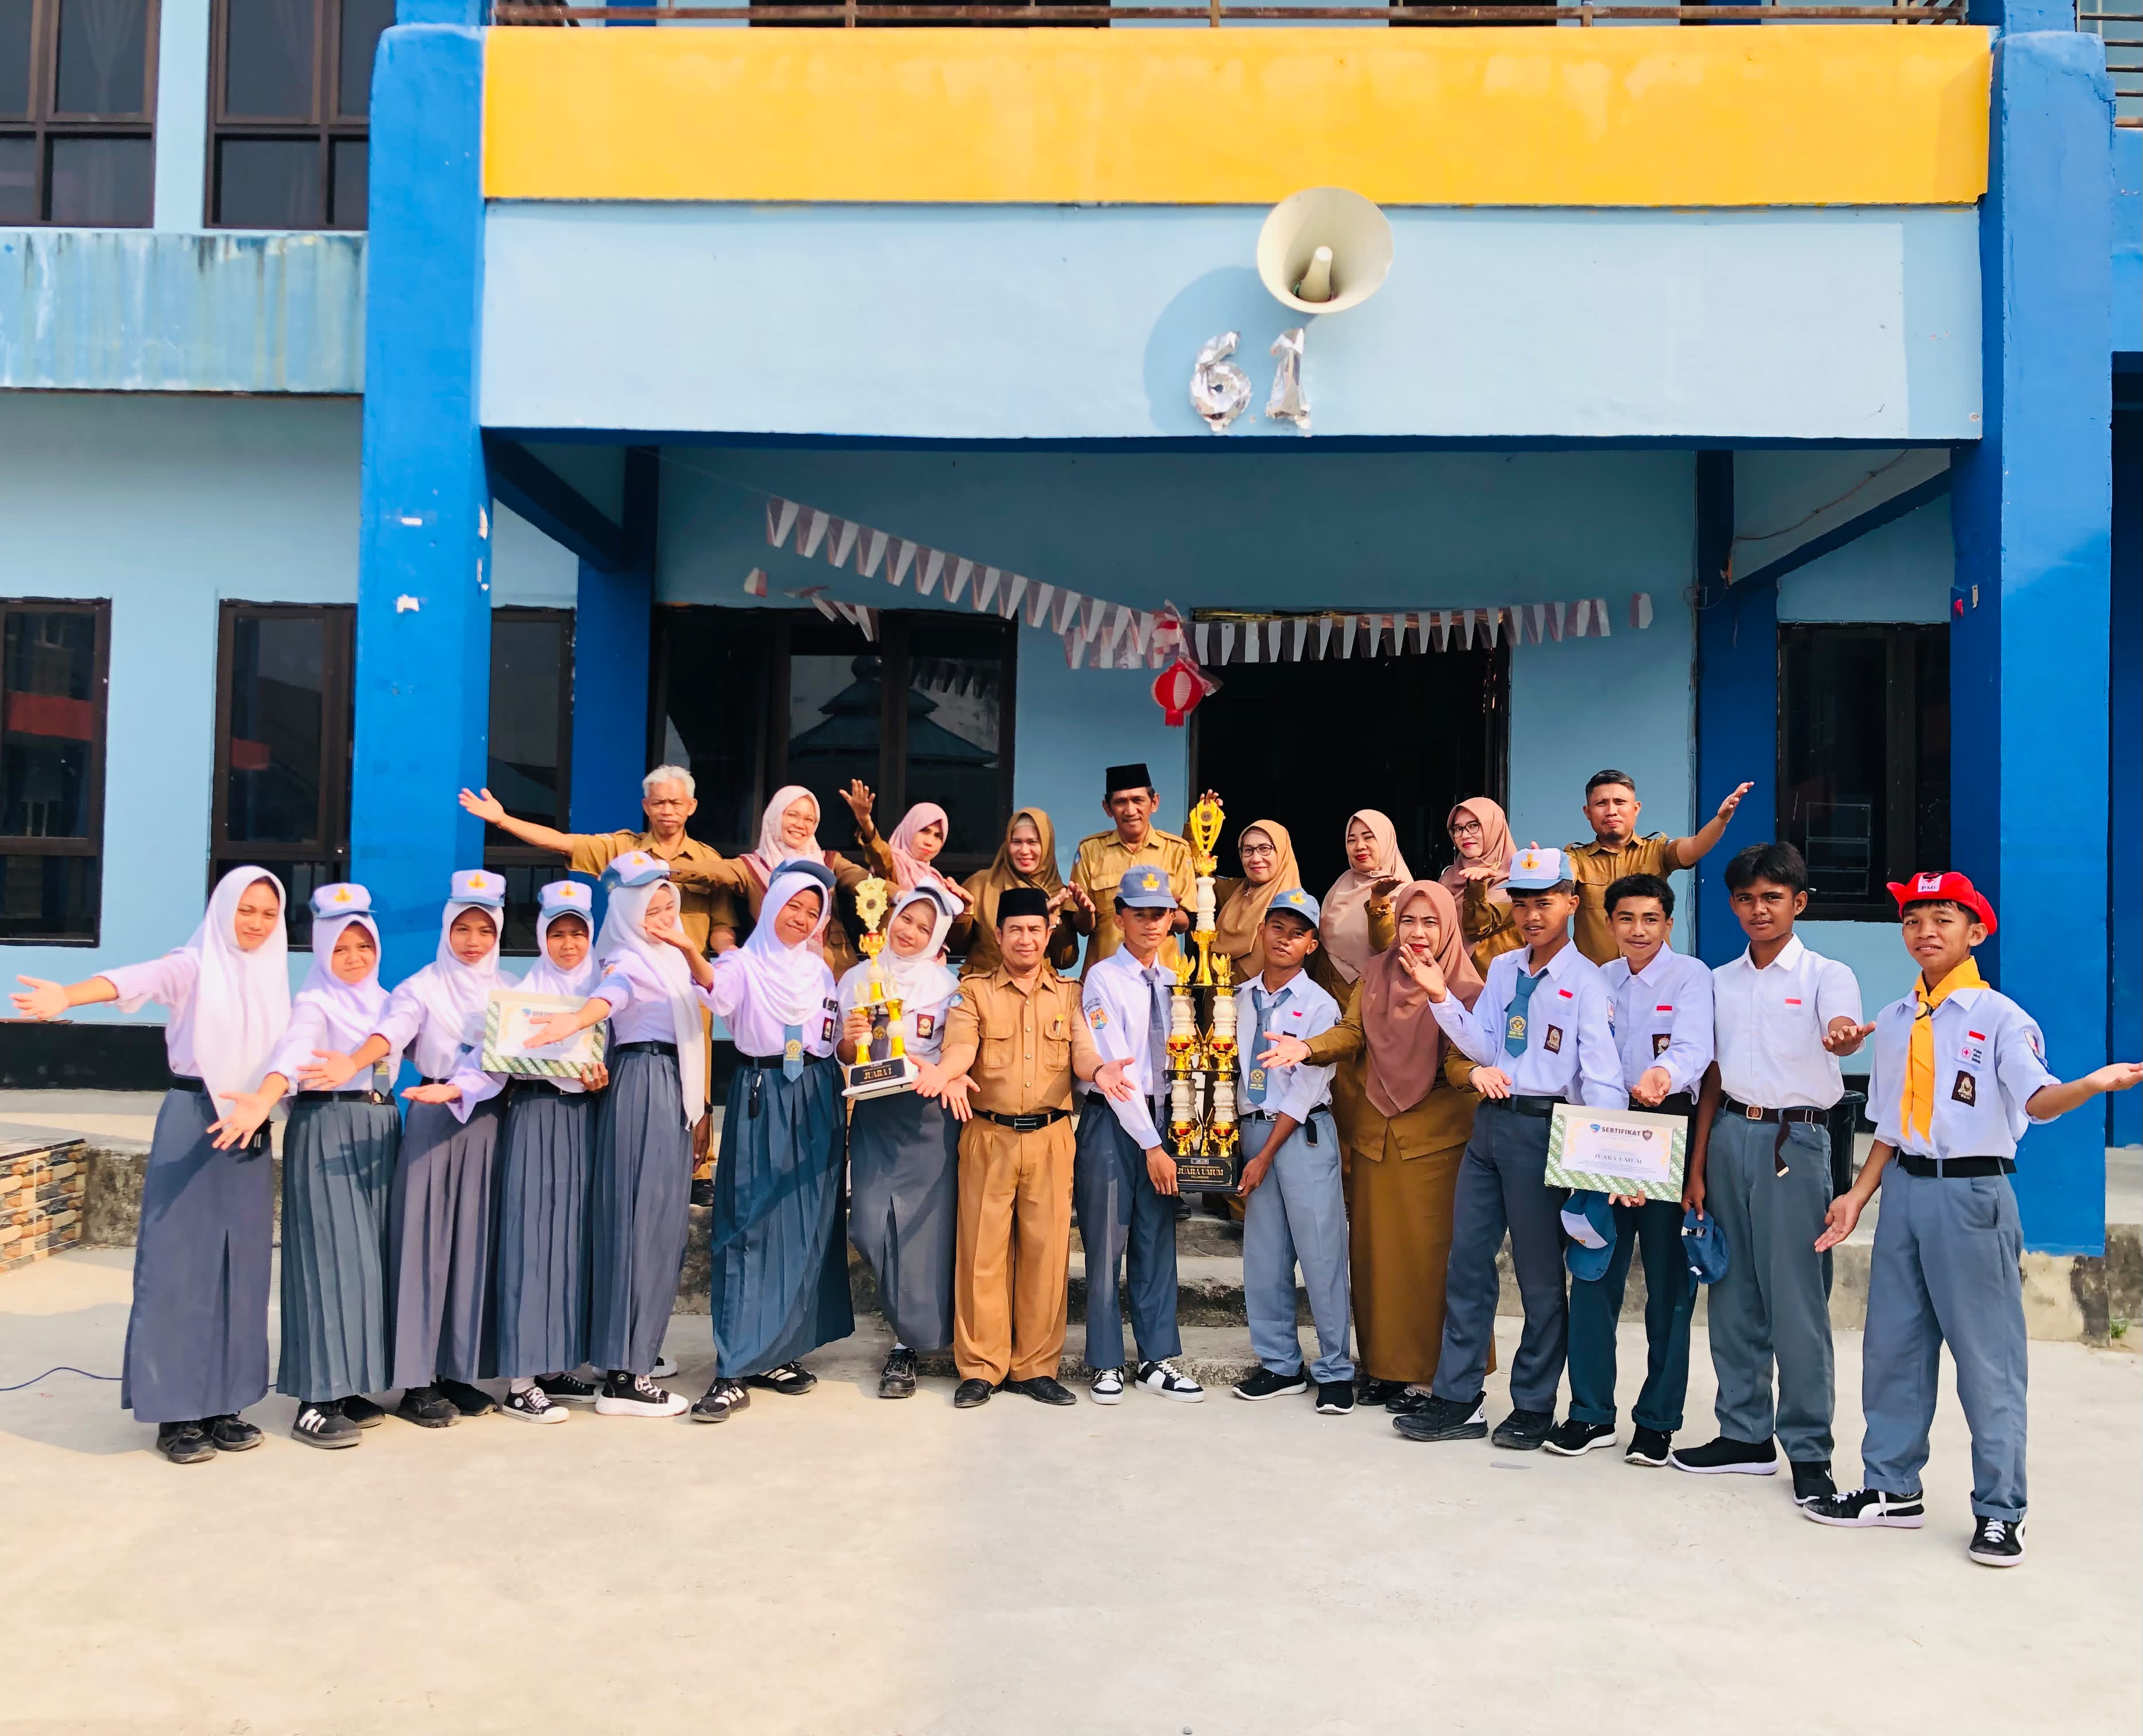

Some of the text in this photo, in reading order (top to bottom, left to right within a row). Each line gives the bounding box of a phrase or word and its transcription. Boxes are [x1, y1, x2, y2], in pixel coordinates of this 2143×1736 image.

[1189, 327, 1312, 432] 61
[863, 1068, 888, 1080] JUARA
[1602, 1127, 1641, 1136] SERTIFIKAT
[1201, 1168, 1224, 1176] UMUM
